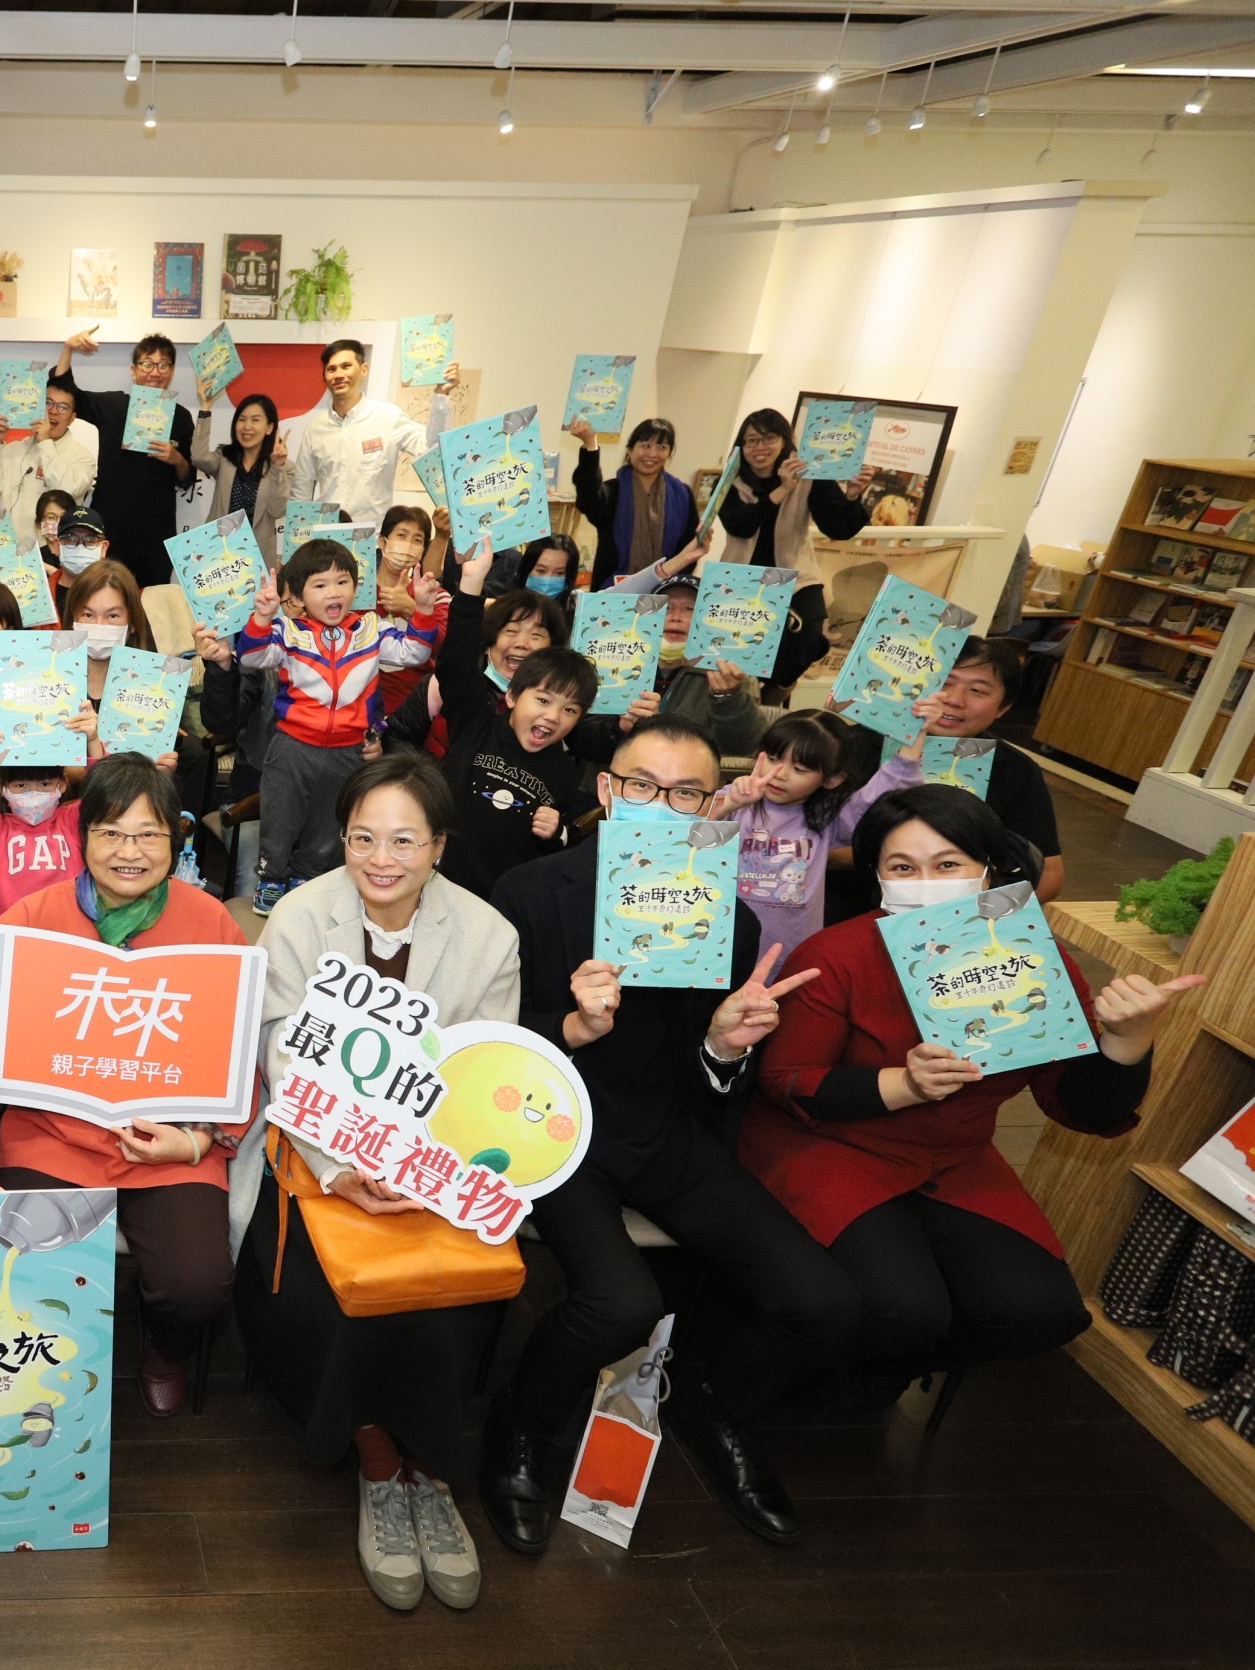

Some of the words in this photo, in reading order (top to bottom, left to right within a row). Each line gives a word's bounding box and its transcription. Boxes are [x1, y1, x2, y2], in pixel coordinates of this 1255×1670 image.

[462, 462, 528, 496] 茶的時空之旅
[193, 558, 249, 588] 茶的時空之旅
[708, 605, 770, 622] 茶的時空之旅
[587, 640, 646, 656] 茶的時空之旅
[875, 634, 938, 672] 茶的時空之旅
[116, 689, 170, 709] 茶的時空之旅
[473, 753, 554, 807] CREATIVE
[7, 834, 72, 876] GAP
[620, 885, 713, 905] 茶的時空之旅
[927, 954, 1036, 997] 茶的時空之旅
[54, 966, 192, 1057] 未來
[313, 959, 430, 1037] 2023
[51, 1053, 183, 1085] 親子學習平台
[285, 1010, 444, 1119] 最Q的
[271, 1072, 524, 1237] 聖誕禮物
